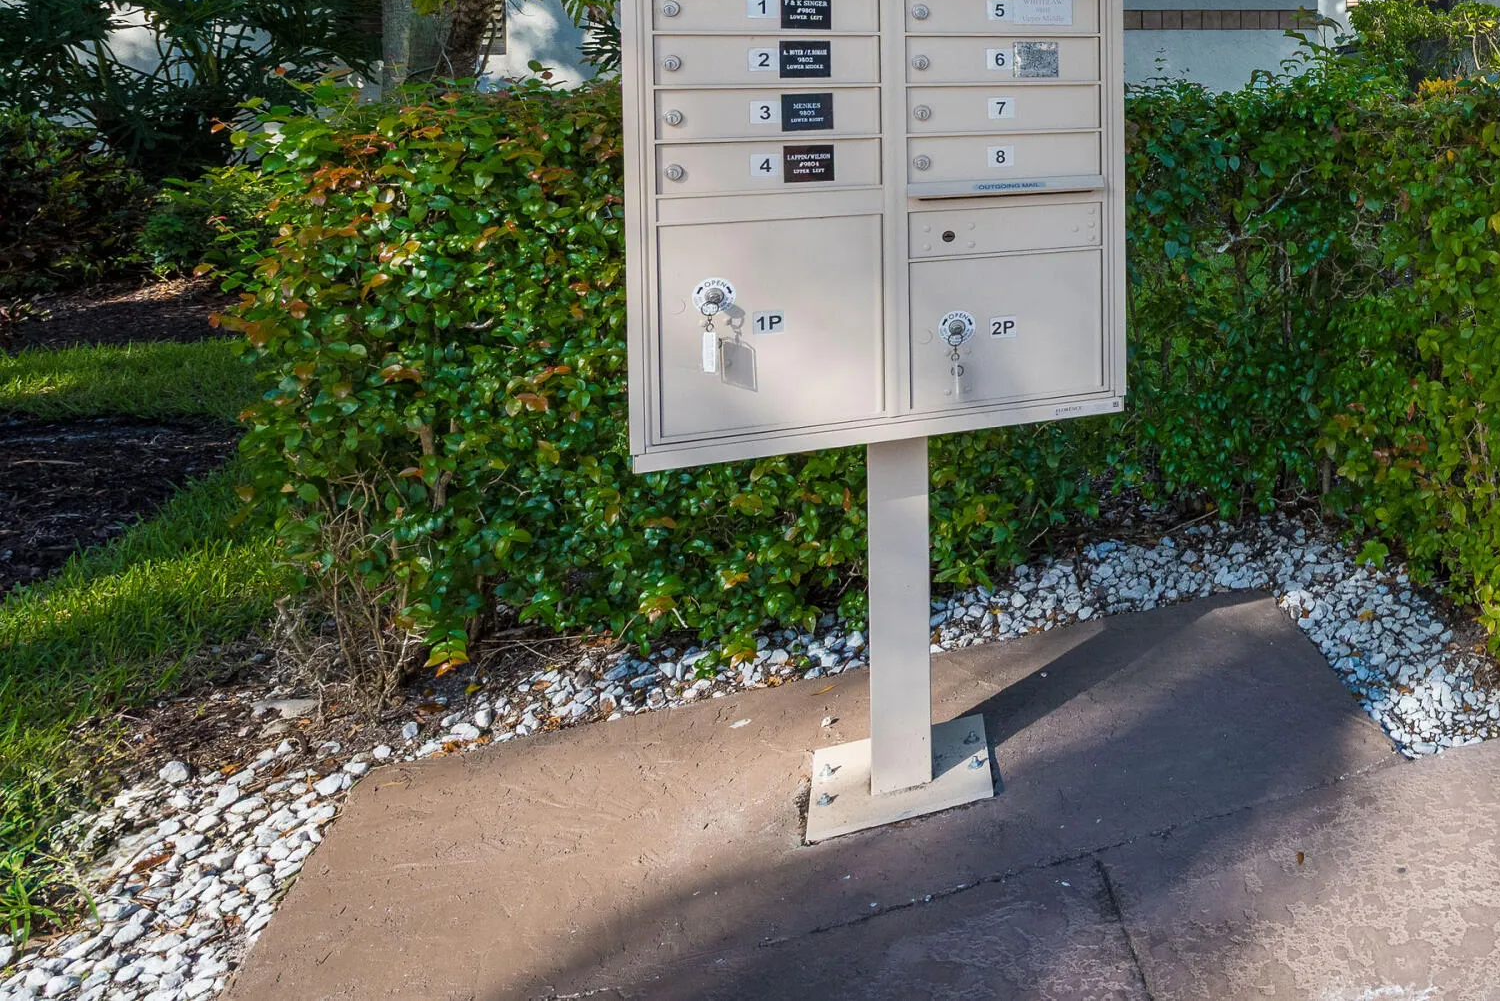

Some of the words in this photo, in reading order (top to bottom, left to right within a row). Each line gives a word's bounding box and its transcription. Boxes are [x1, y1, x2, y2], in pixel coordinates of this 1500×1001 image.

[757, 0, 767, 14] 1
[994, 3, 1005, 17] 5
[758, 52, 770, 67] 2
[994, 52, 1005, 66] 6
[759, 105, 771, 120] 3
[792, 102, 821, 110] MENKES
[996, 101, 1006, 115] 7
[995, 150, 1006, 164] 8
[759, 158, 772, 173] 4
[704, 279, 727, 288] OPEN
[756, 315, 782, 331] 1P
[948, 312, 968, 320] OPEN
[991, 320, 1015, 336] 2P
